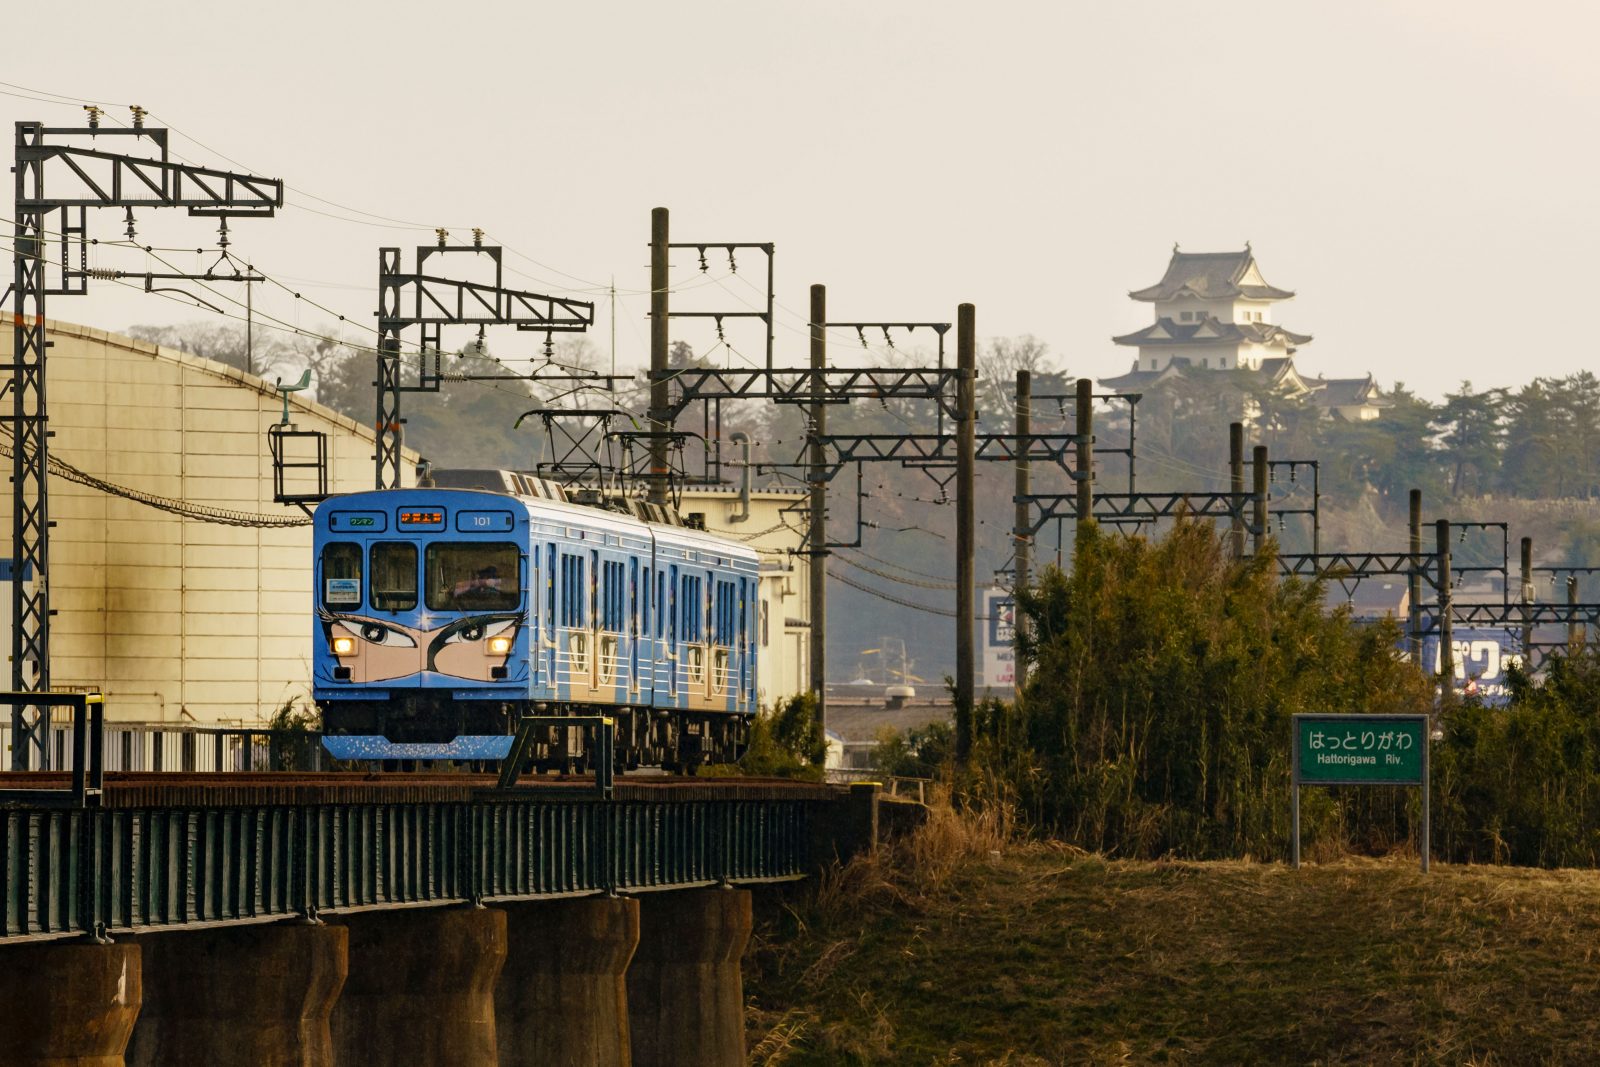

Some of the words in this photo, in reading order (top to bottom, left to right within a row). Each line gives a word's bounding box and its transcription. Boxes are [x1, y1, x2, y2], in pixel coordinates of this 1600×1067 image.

[474, 517, 490, 526] 101
[1309, 731, 1412, 750] はっとりがわ
[1317, 753, 1377, 766] Hattorigawa
[1385, 753, 1404, 765] Riv.
